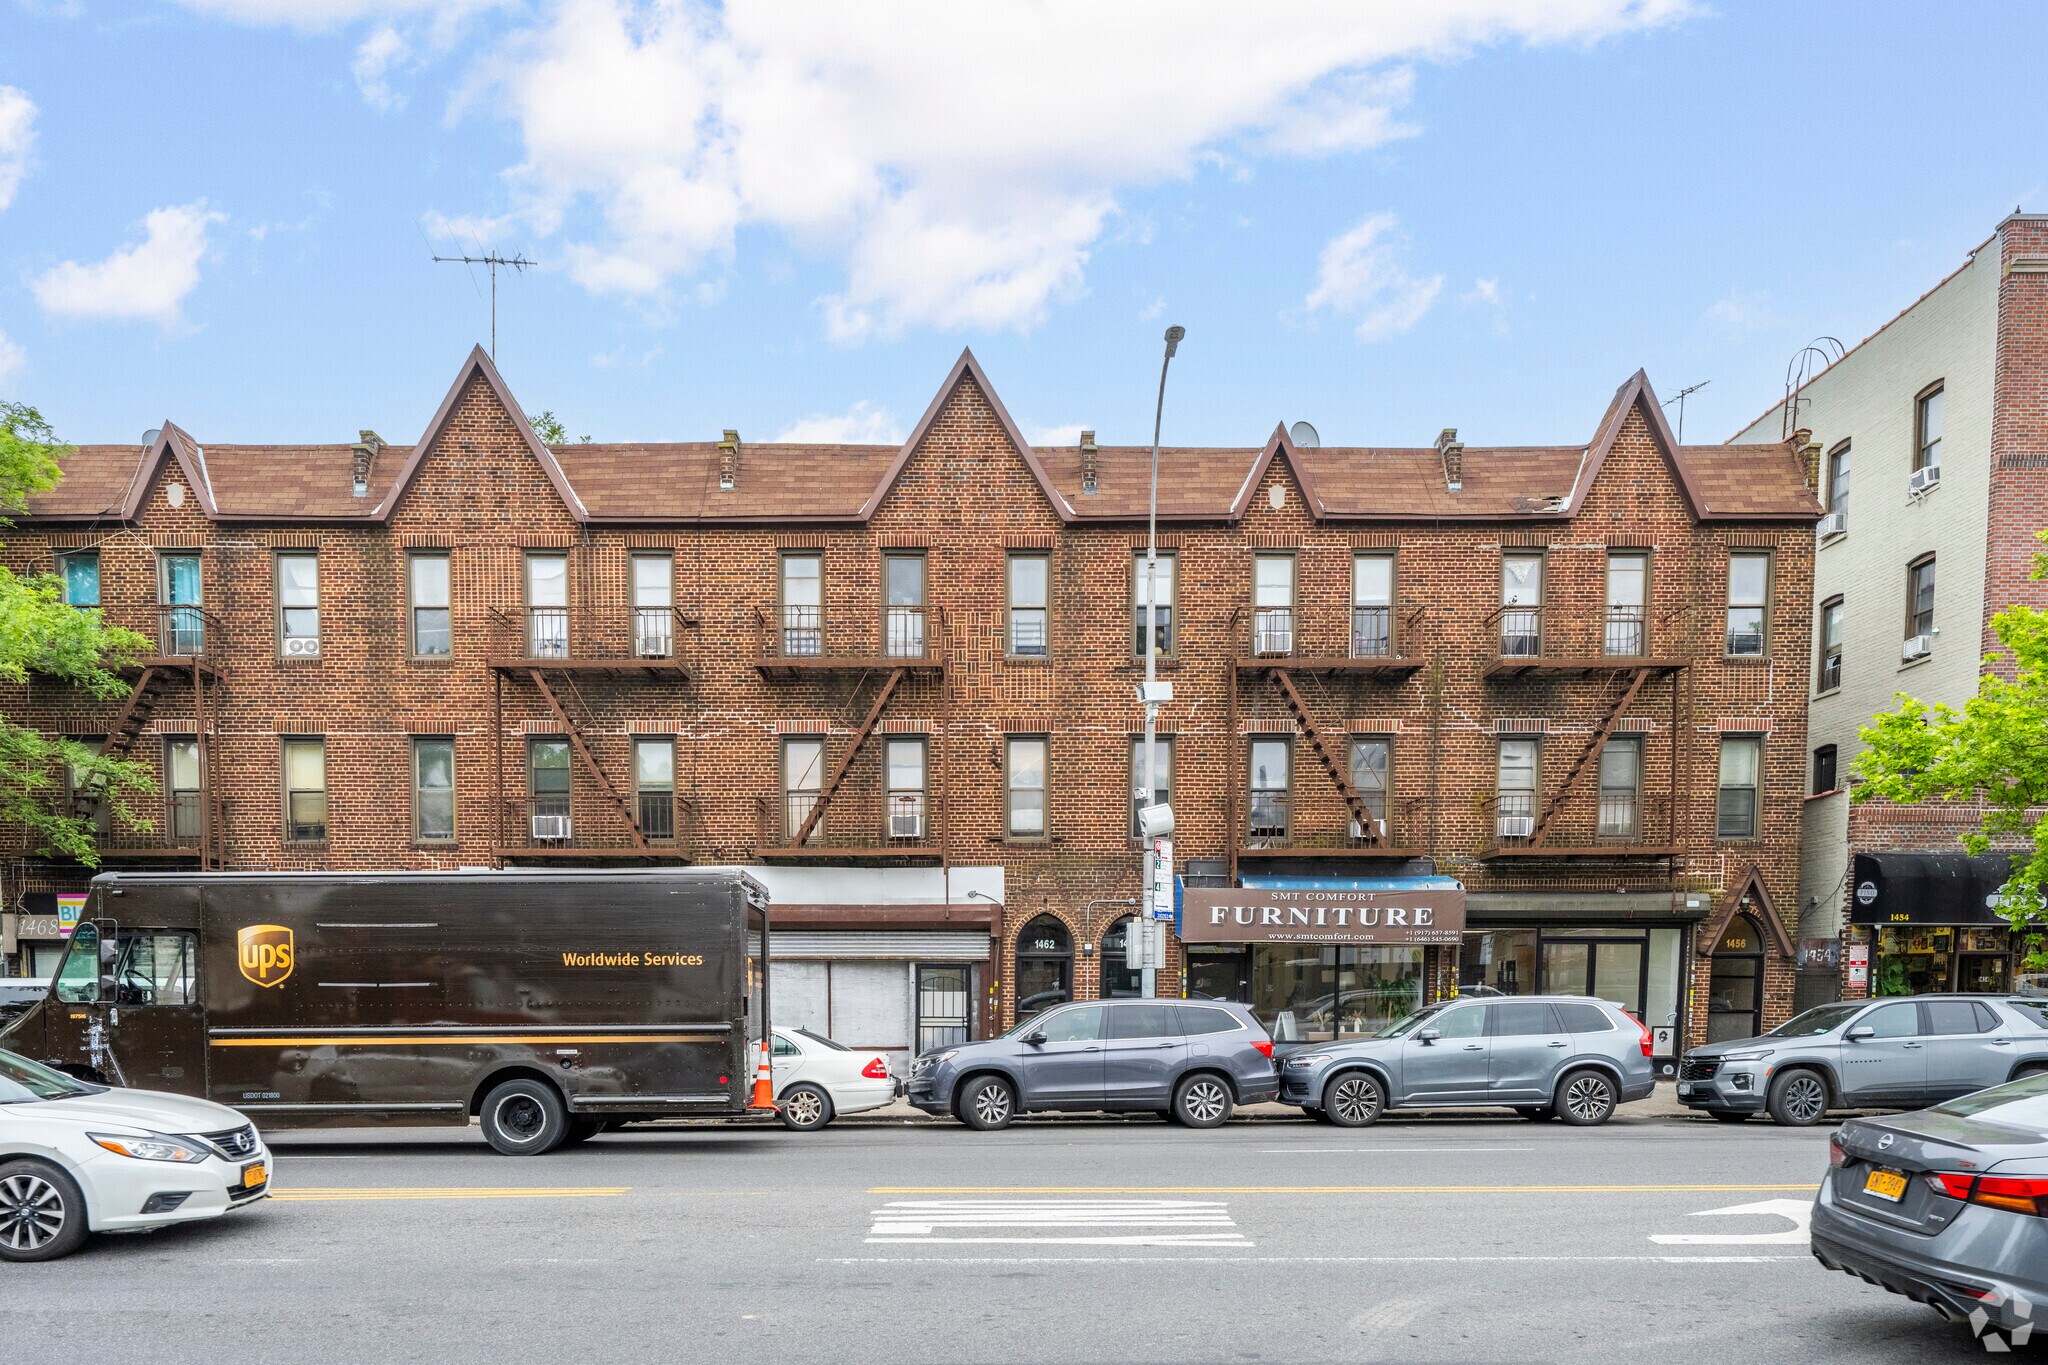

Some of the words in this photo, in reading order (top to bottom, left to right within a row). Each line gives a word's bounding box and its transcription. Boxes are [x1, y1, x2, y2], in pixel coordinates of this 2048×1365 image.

[1271, 892, 1300, 900] SMT
[1306, 892, 1376, 901] COMFORT
[1209, 906, 1434, 927] FURNITURE
[1890, 913, 1910, 921] 1454
[19, 919, 58, 935] 1468
[1034, 940, 1055, 949] 1462
[1726, 939, 1747, 949] 1456
[242, 943, 291, 978] ups
[562, 952, 640, 967] Worldwide
[643, 952, 703, 966] Services
[1804, 949, 1831, 962] 1454
